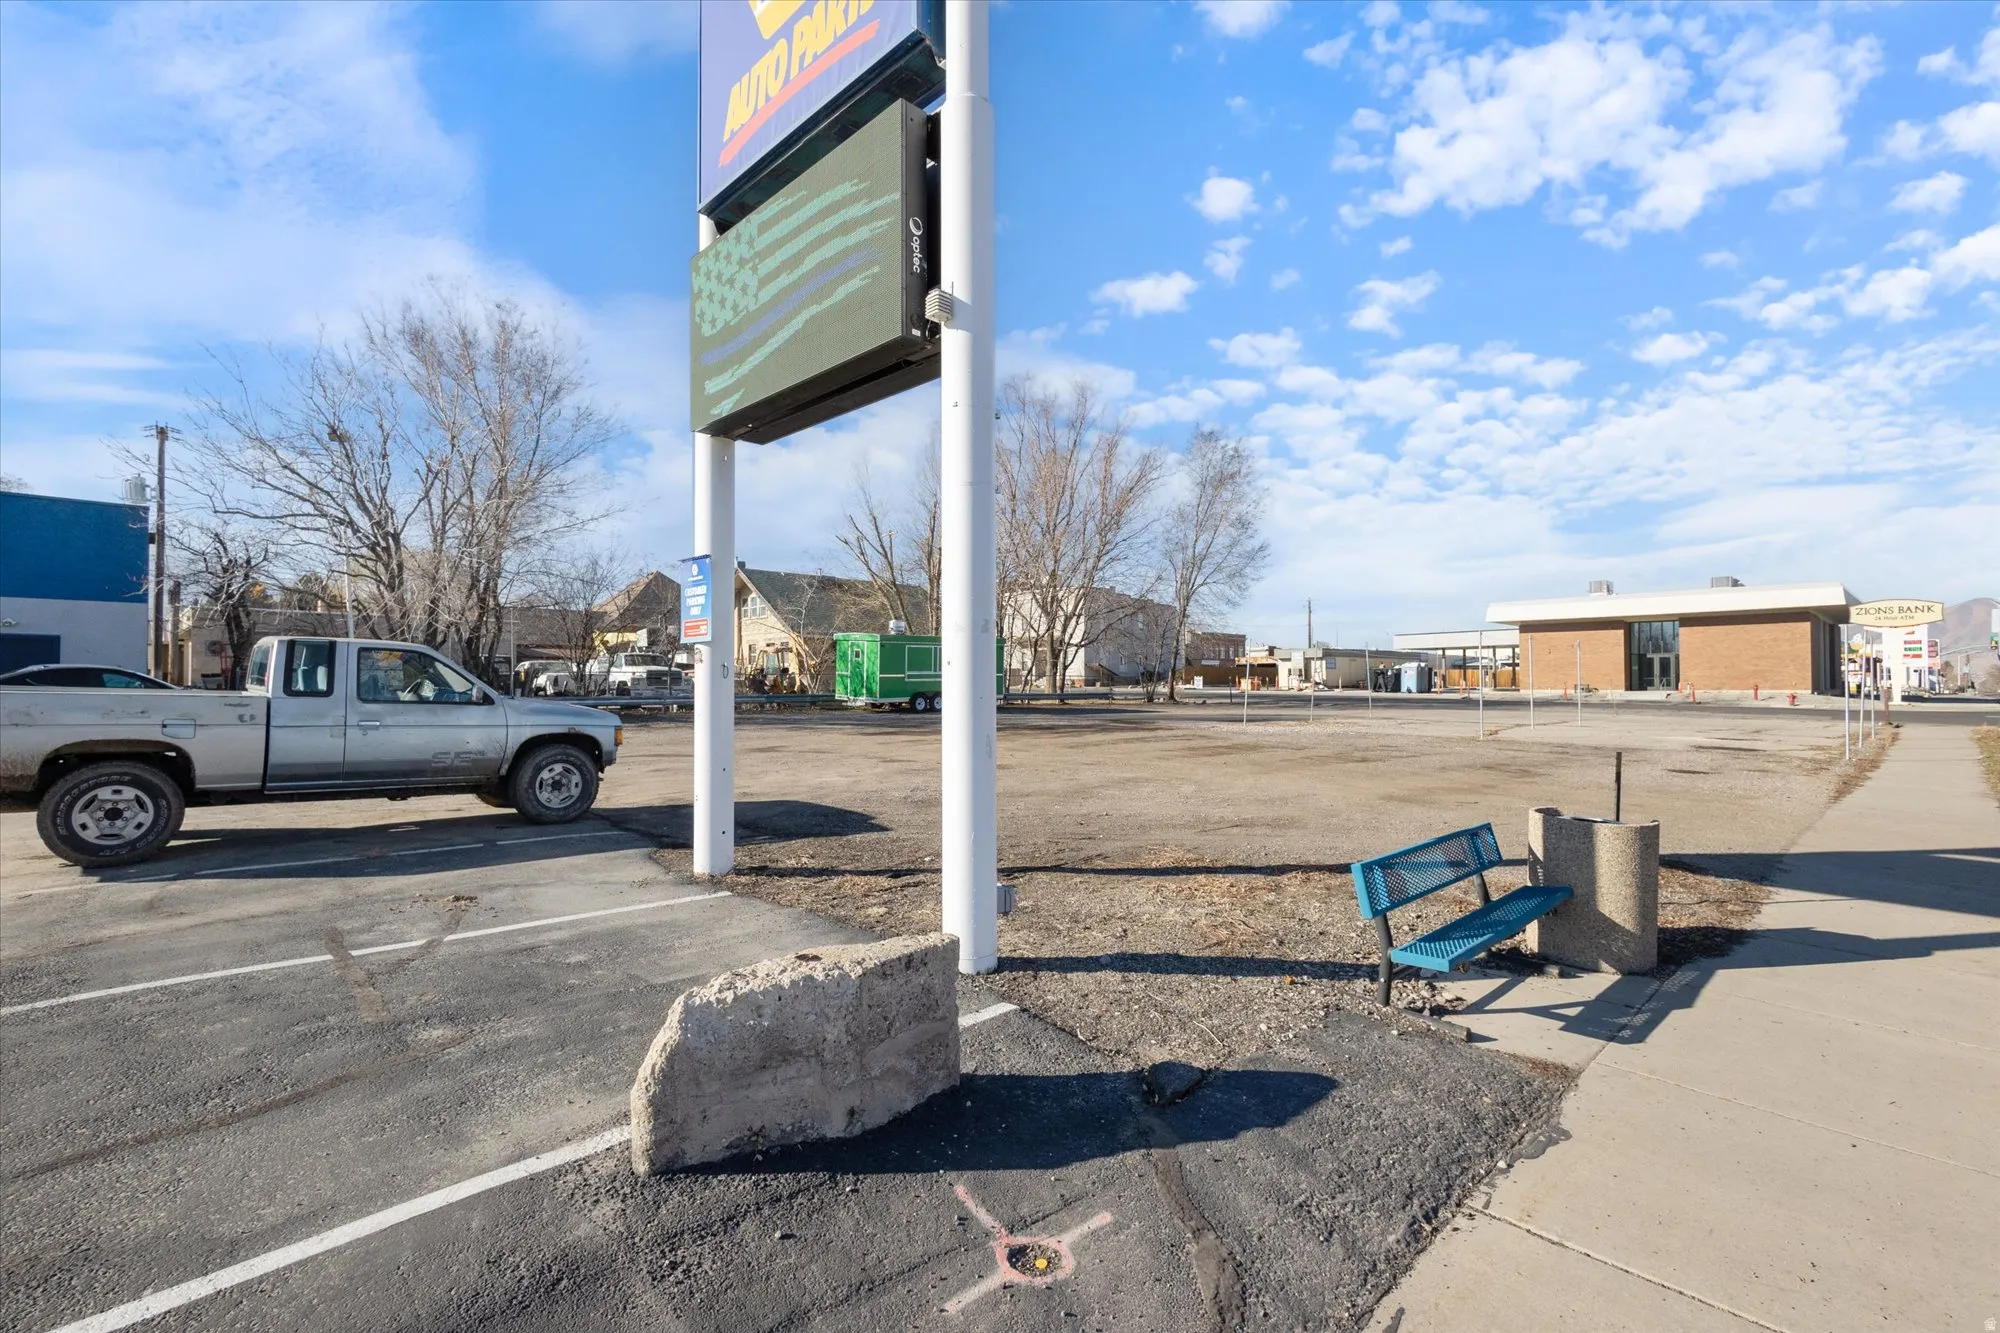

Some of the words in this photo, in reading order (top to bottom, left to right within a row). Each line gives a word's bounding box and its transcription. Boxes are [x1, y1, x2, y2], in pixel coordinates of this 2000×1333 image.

[723, 38, 788, 142] AUTO
[1856, 607, 1894, 615] ZIONS
[1898, 605, 1935, 614] BANK
